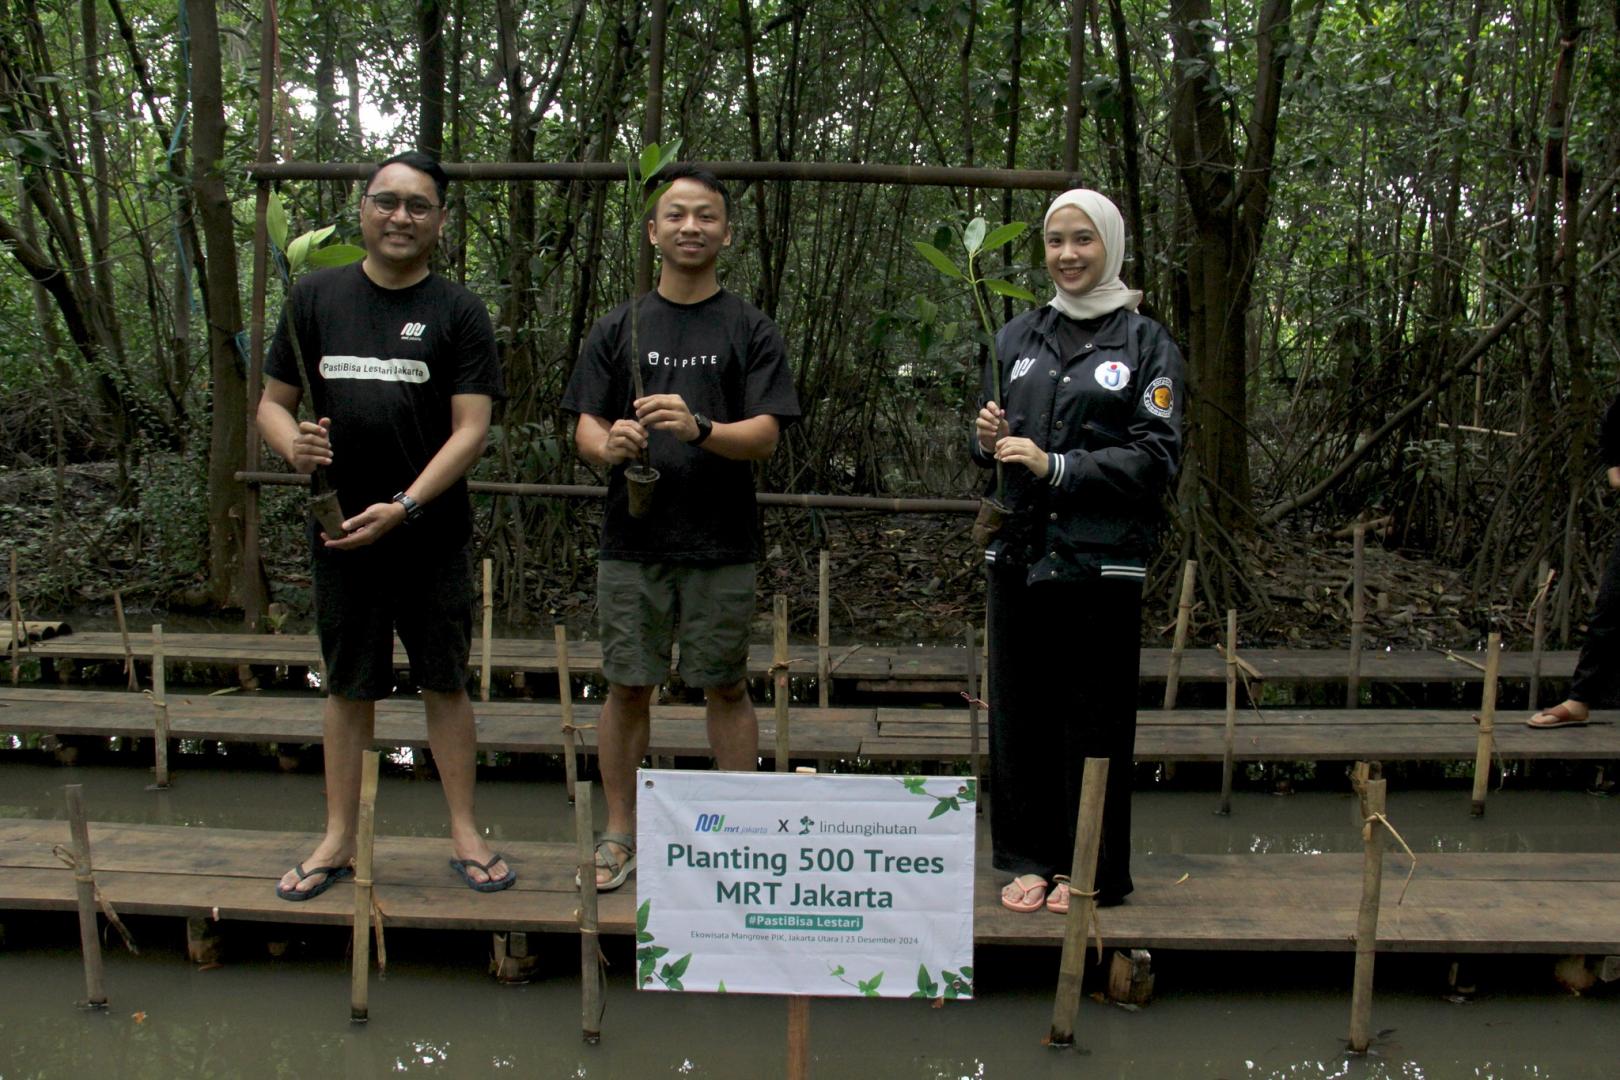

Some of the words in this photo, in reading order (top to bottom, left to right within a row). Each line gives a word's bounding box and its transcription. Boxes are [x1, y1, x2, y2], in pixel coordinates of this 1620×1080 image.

[663, 355, 717, 368] CIPETE
[323, 362, 361, 373] PastiBisa
[363, 364, 392, 375] Lestari
[394, 366, 424, 377] Jakarta
[724, 825, 739, 833] mrt
[739, 825, 768, 834] jakarta
[777, 819, 789, 833] X
[819, 820, 917, 836] lindungihutan
[667, 843, 787, 876] Planting
[799, 847, 854, 872] 500
[864, 849, 944, 874] Trees
[716, 881, 782, 905] MRT
[790, 884, 893, 909] Jakarta
[748, 915, 813, 928] #PastiBisa
[817, 916, 860, 928] Lestari
[690, 931, 729, 939] Ekowisata
[731, 932, 769, 941] Mangrove
[788, 934, 816, 942] Jakarta
[817, 935, 838, 943] Utara
[857, 936, 896, 944] Desember
[898, 937, 919, 945] 2024
